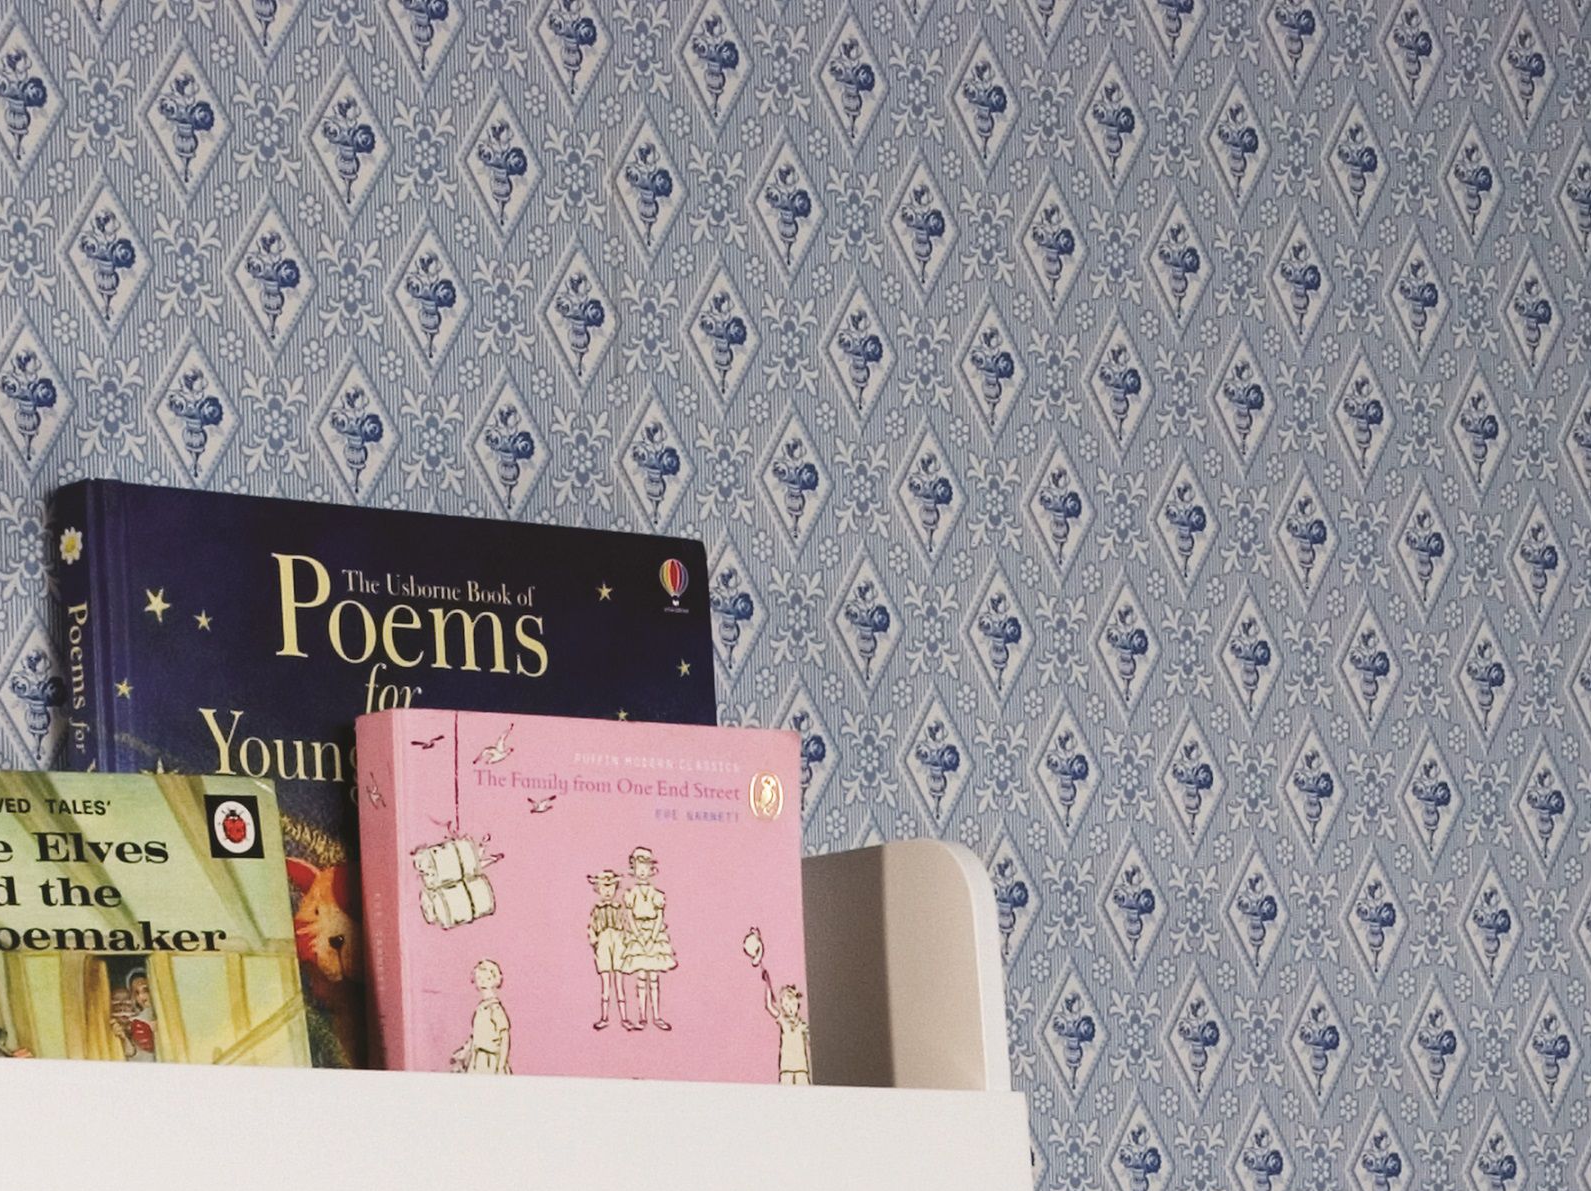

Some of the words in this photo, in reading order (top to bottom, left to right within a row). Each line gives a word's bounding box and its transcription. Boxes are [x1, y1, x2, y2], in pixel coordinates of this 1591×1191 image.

[341, 568, 380, 595] The
[386, 573, 462, 602] Usborne
[467, 580, 511, 606] Book
[516, 586, 536, 608] of
[271, 552, 549, 678] Poems
[67, 601, 89, 711] Poems
[364, 663, 423, 715] for
[69, 717, 91, 754] for
[198, 707, 358, 783] Youn
[473, 769, 506, 788] The
[511, 771, 569, 796] Family
[573, 775, 611, 793] from
[617, 778, 653, 796] One
[657, 780, 689, 799] End
[694, 783, 741, 801] Street
[31, 831, 170, 865] Elves
[38, 878, 123, 908] the
